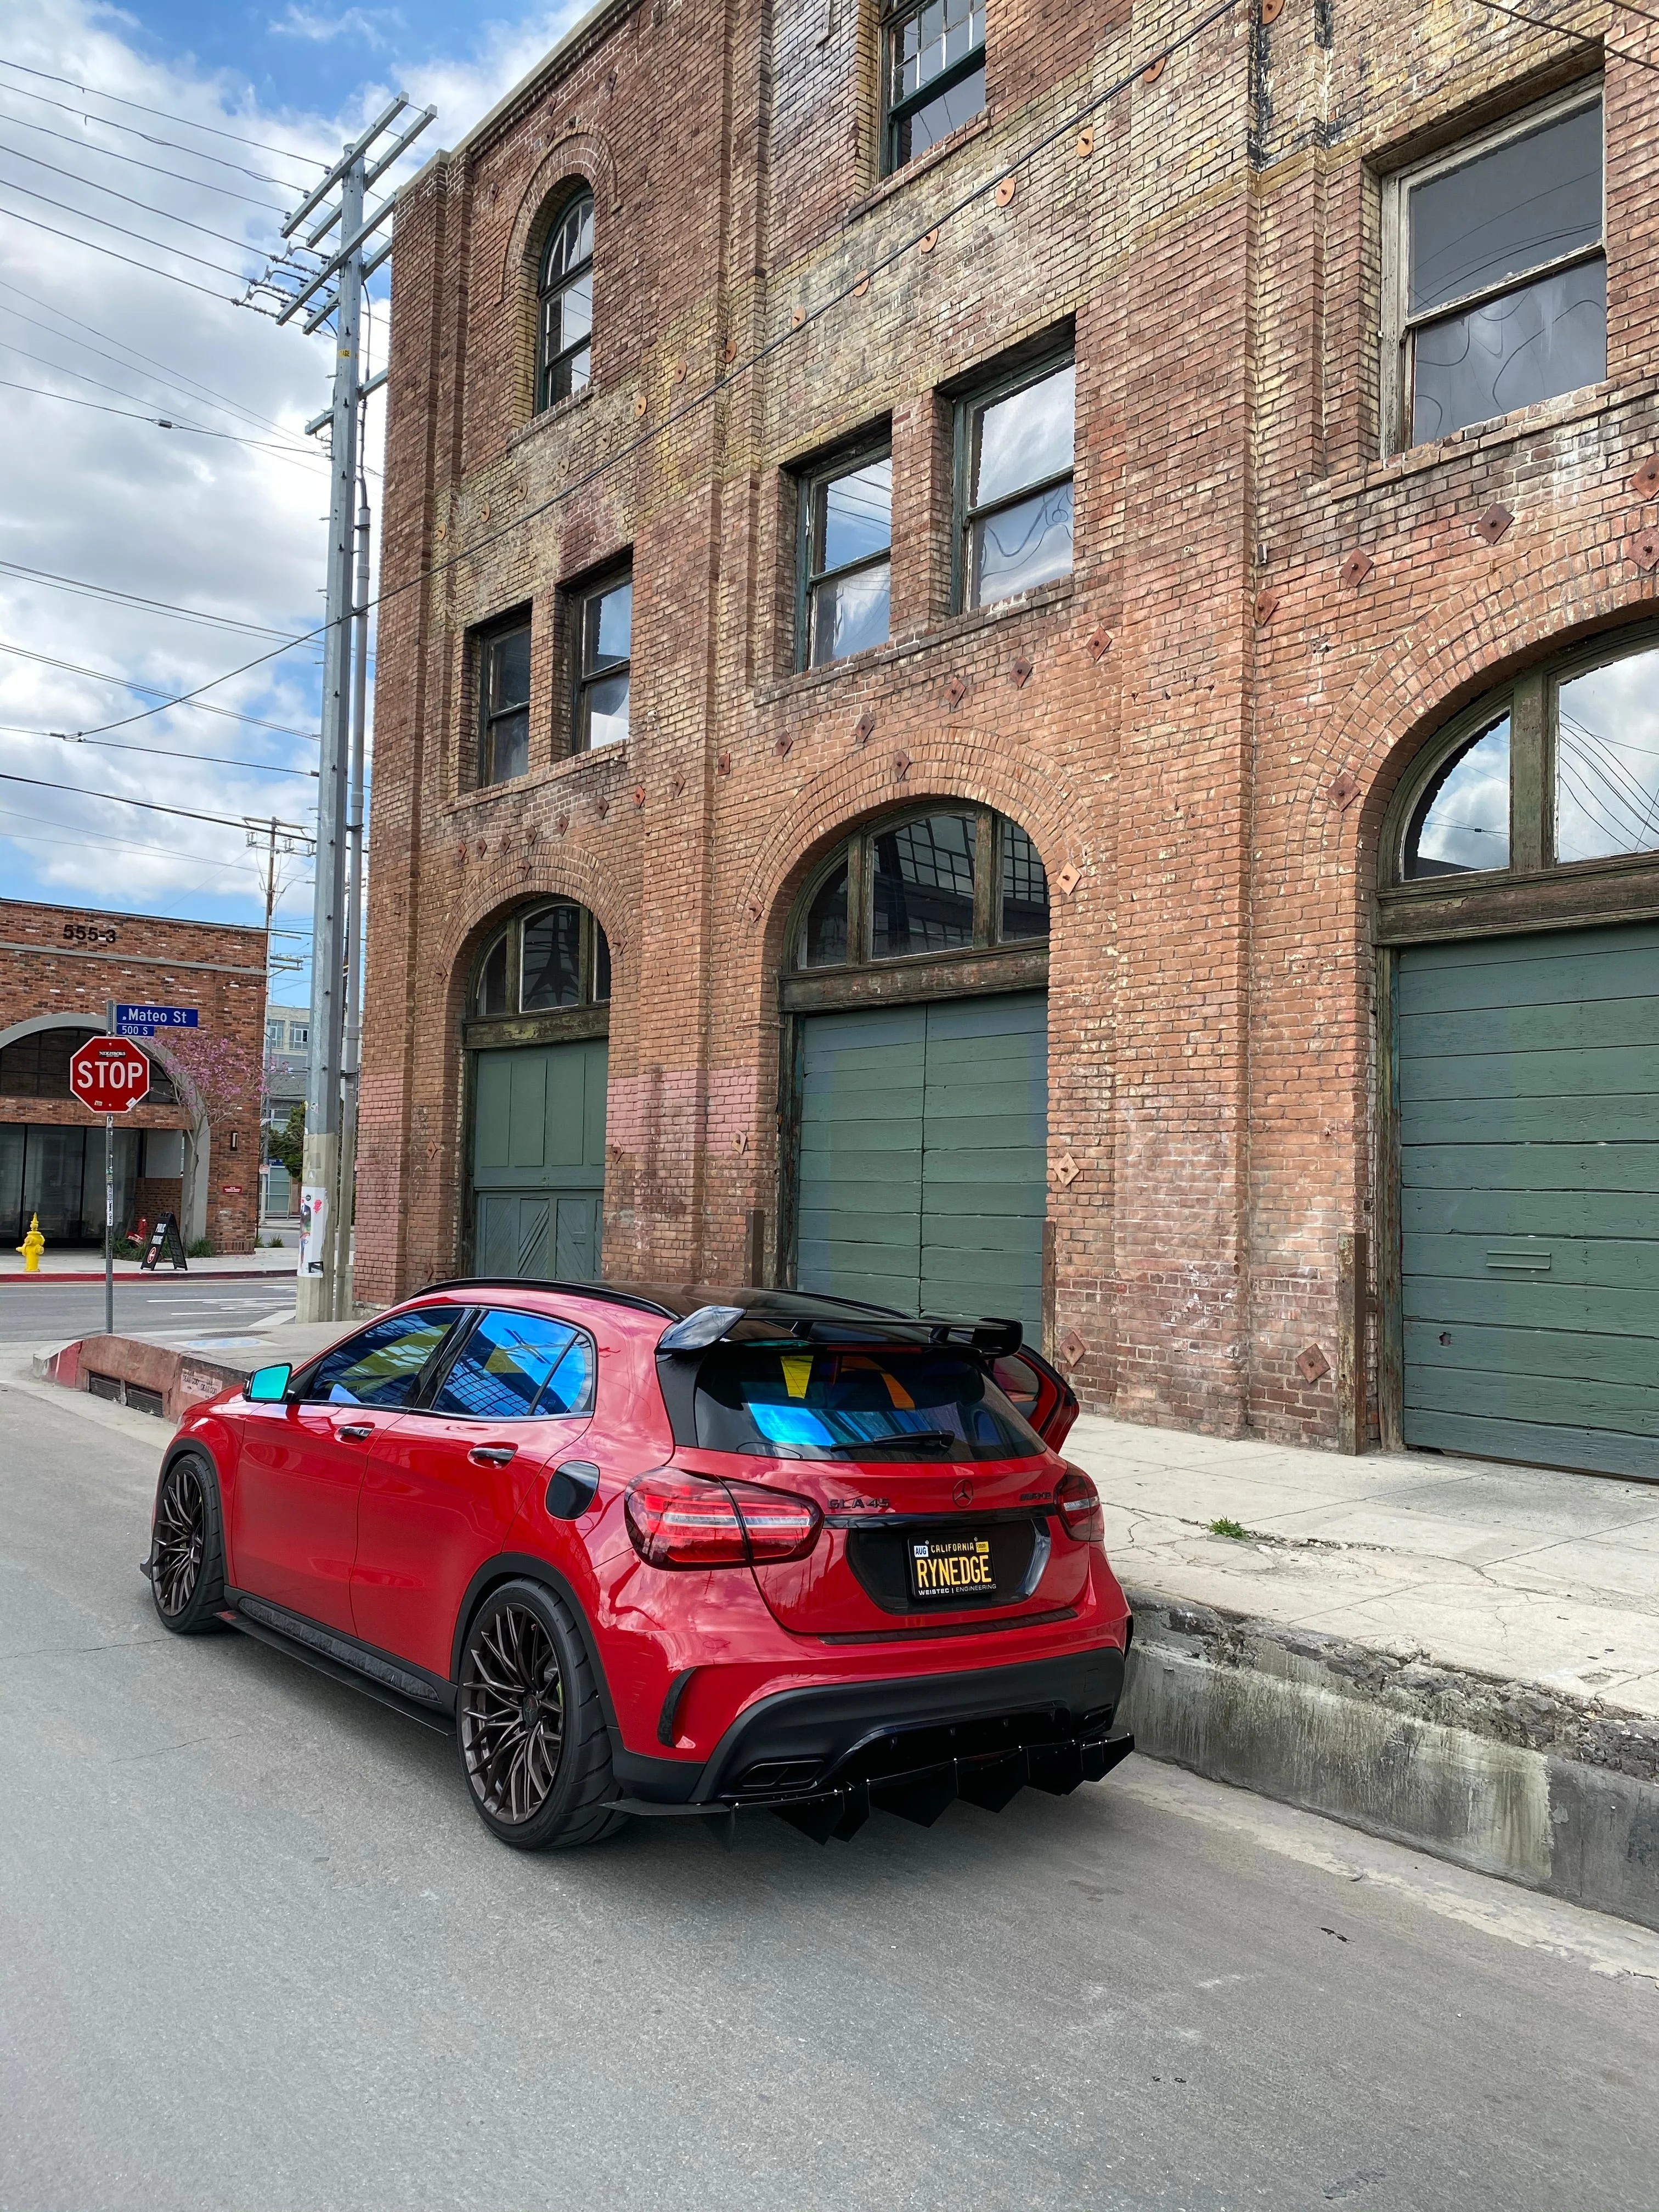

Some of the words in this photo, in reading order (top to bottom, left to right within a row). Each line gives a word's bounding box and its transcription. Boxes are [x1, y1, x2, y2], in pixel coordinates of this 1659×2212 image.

[63, 924, 116, 943] 555-3
[128, 1008, 167, 1022] Mateo
[173, 1011, 187, 1024] St
[122, 1025, 138, 1035] 500
[143, 1026, 148, 1035] S
[77, 1060, 143, 1088] STOP
[915, 1547, 927, 1555] AUG
[930, 1542, 974, 1554] CALIFORNIA
[917, 1555, 992, 1588] RYNEDGE
[918, 1588, 950, 1596] WEISTEC
[956, 1583, 997, 1593] ENGINEERING
